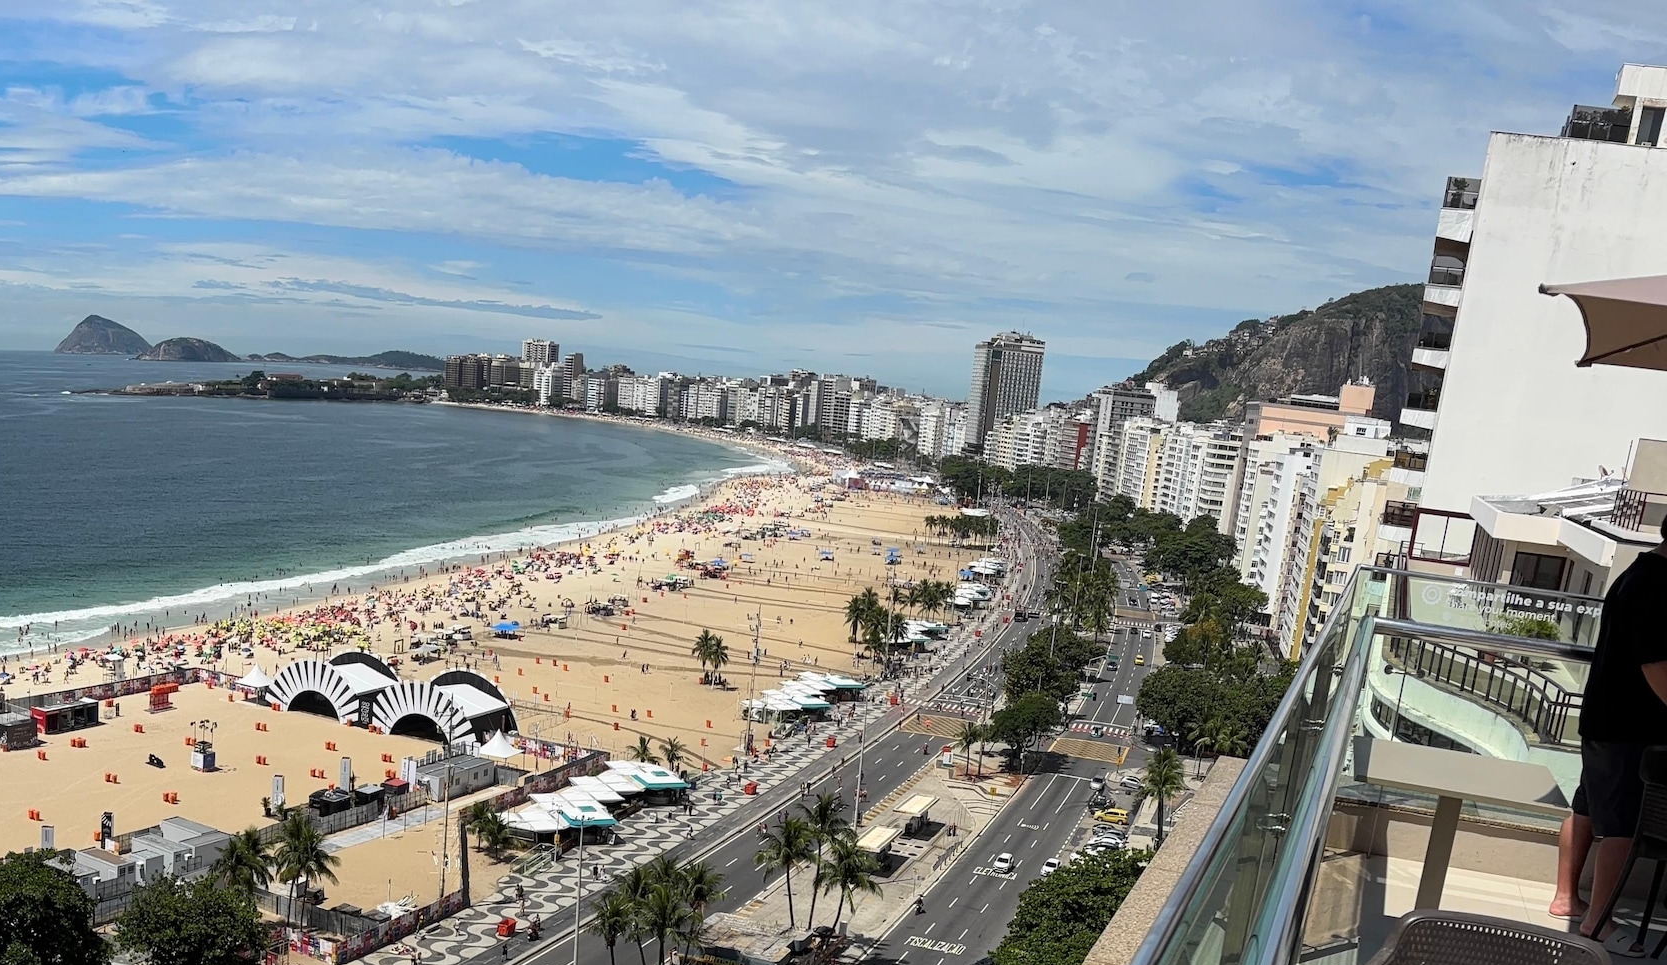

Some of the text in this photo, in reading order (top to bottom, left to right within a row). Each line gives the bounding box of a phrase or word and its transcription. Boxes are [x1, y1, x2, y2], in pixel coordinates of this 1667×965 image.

[1478, 603, 1503, 615] your
[1505, 607, 1556, 623] moment
[1536, 599, 1545, 609] a
[1547, 601, 1573, 613] sua
[904, 936, 967, 956] FISCALIZAÇÃO
